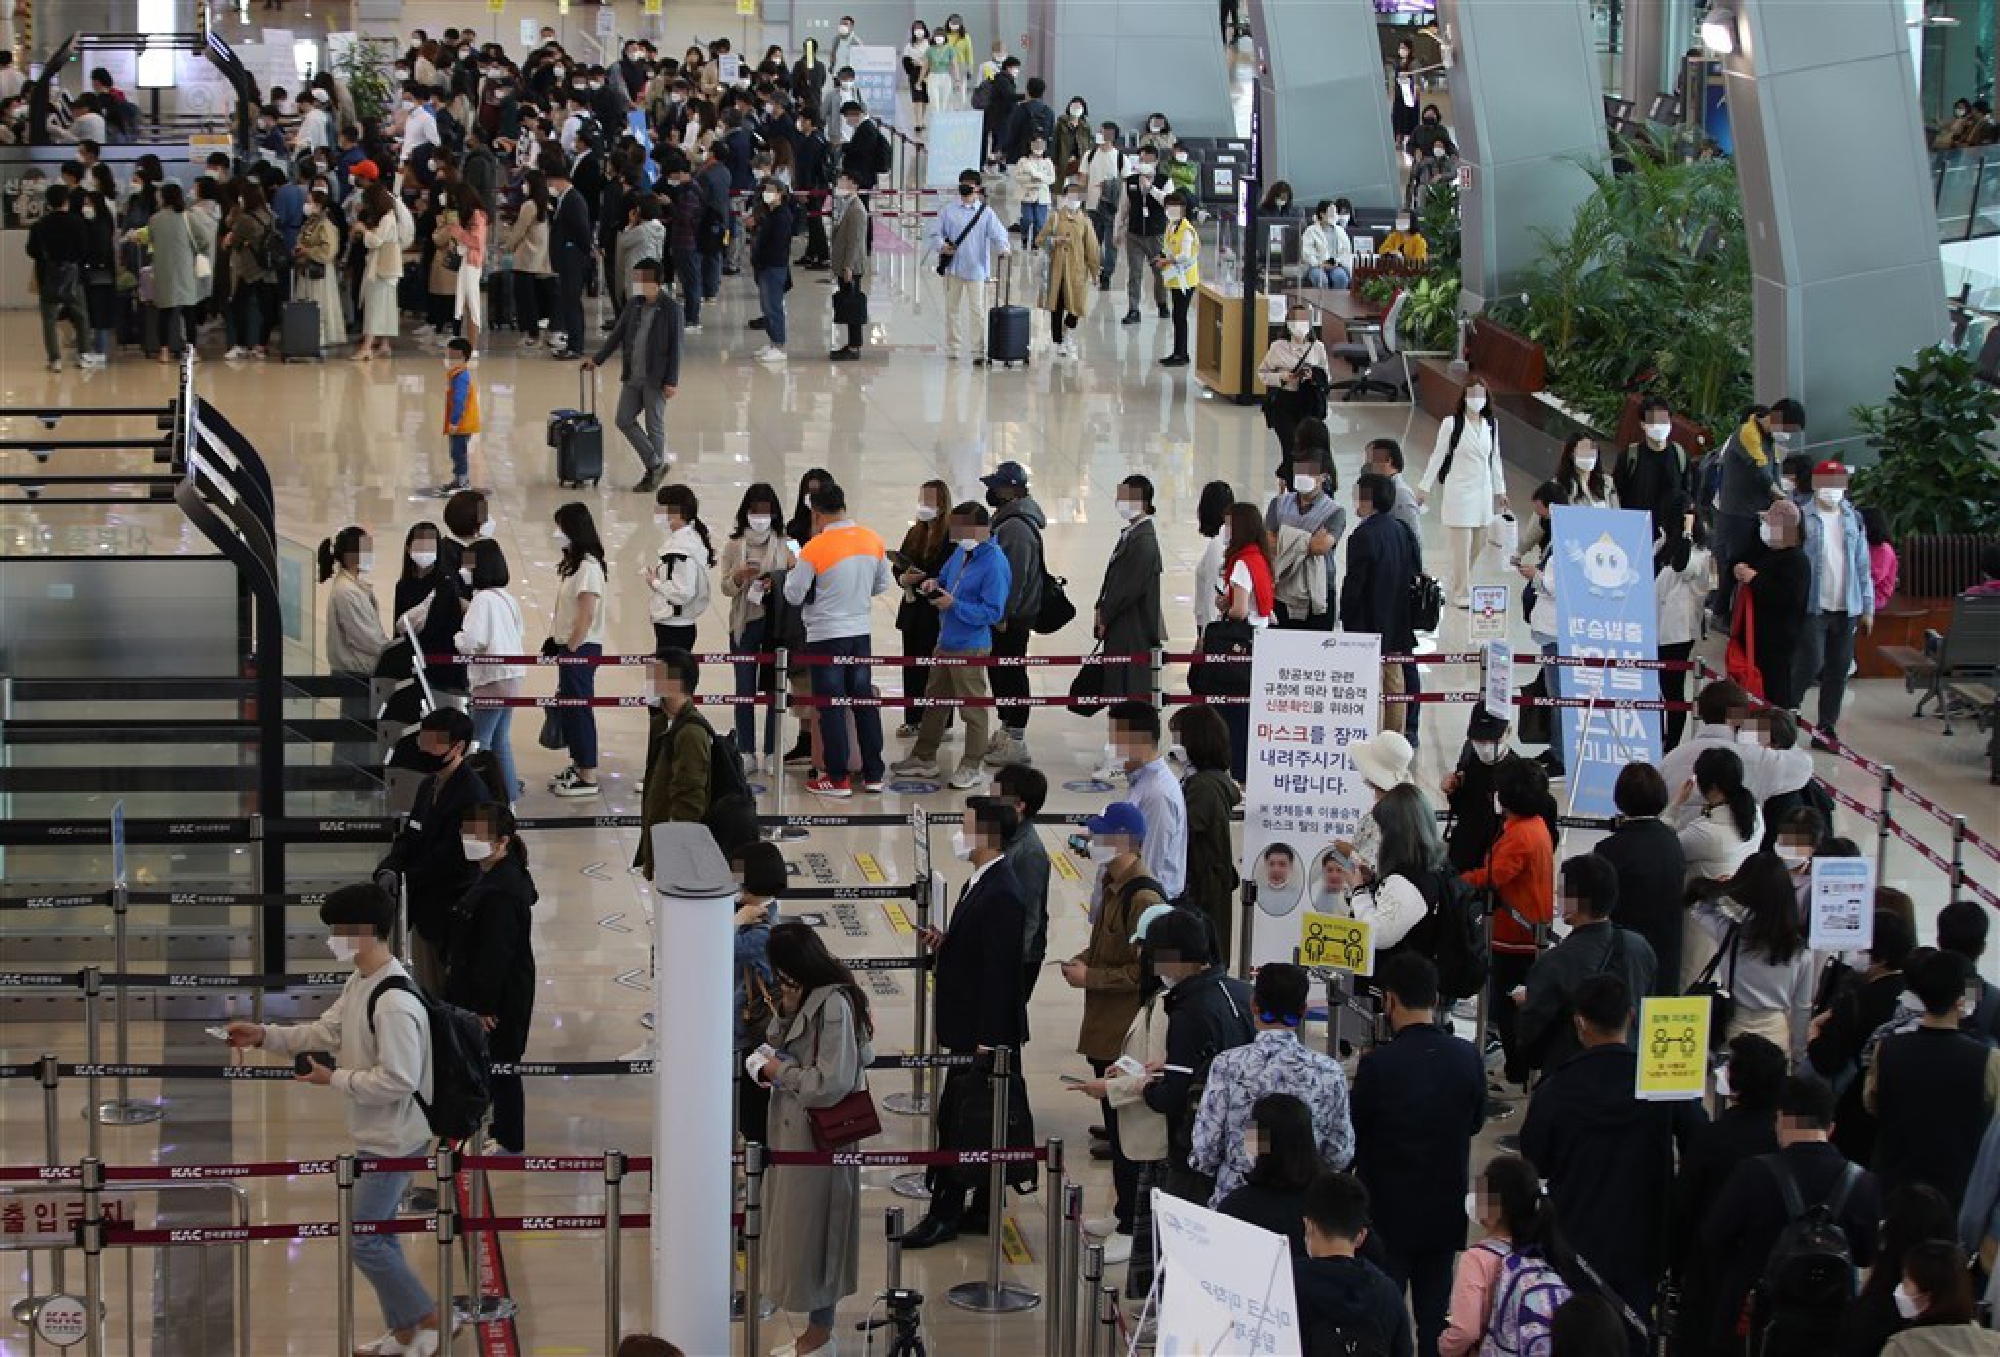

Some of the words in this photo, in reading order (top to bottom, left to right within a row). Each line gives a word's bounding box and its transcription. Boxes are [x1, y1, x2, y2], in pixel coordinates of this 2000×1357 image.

[1264, 683, 1300, 696] 규정에
[1257, 723, 1325, 744] 마스크를
[1274, 774, 1347, 795] 바랍니다.
[0, 974, 20, 984] AC
[170, 975, 198, 986] KAC
[308, 972, 334, 984] KAC
[76, 1065, 104, 1075] KAC
[833, 1153, 862, 1165] KAC
[959, 1151, 988, 1163] KAC
[300, 1162, 330, 1173] KAC
[525, 1158, 556, 1170] KAC
[40, 1167, 70, 1178] KAC
[172, 1167, 202, 1178] KAC
[522, 1217, 554, 1228] KAC
[172, 1230, 202, 1241] KAC
[298, 1224, 329, 1236] KAC
[46, 1311, 82, 1325] KAC
